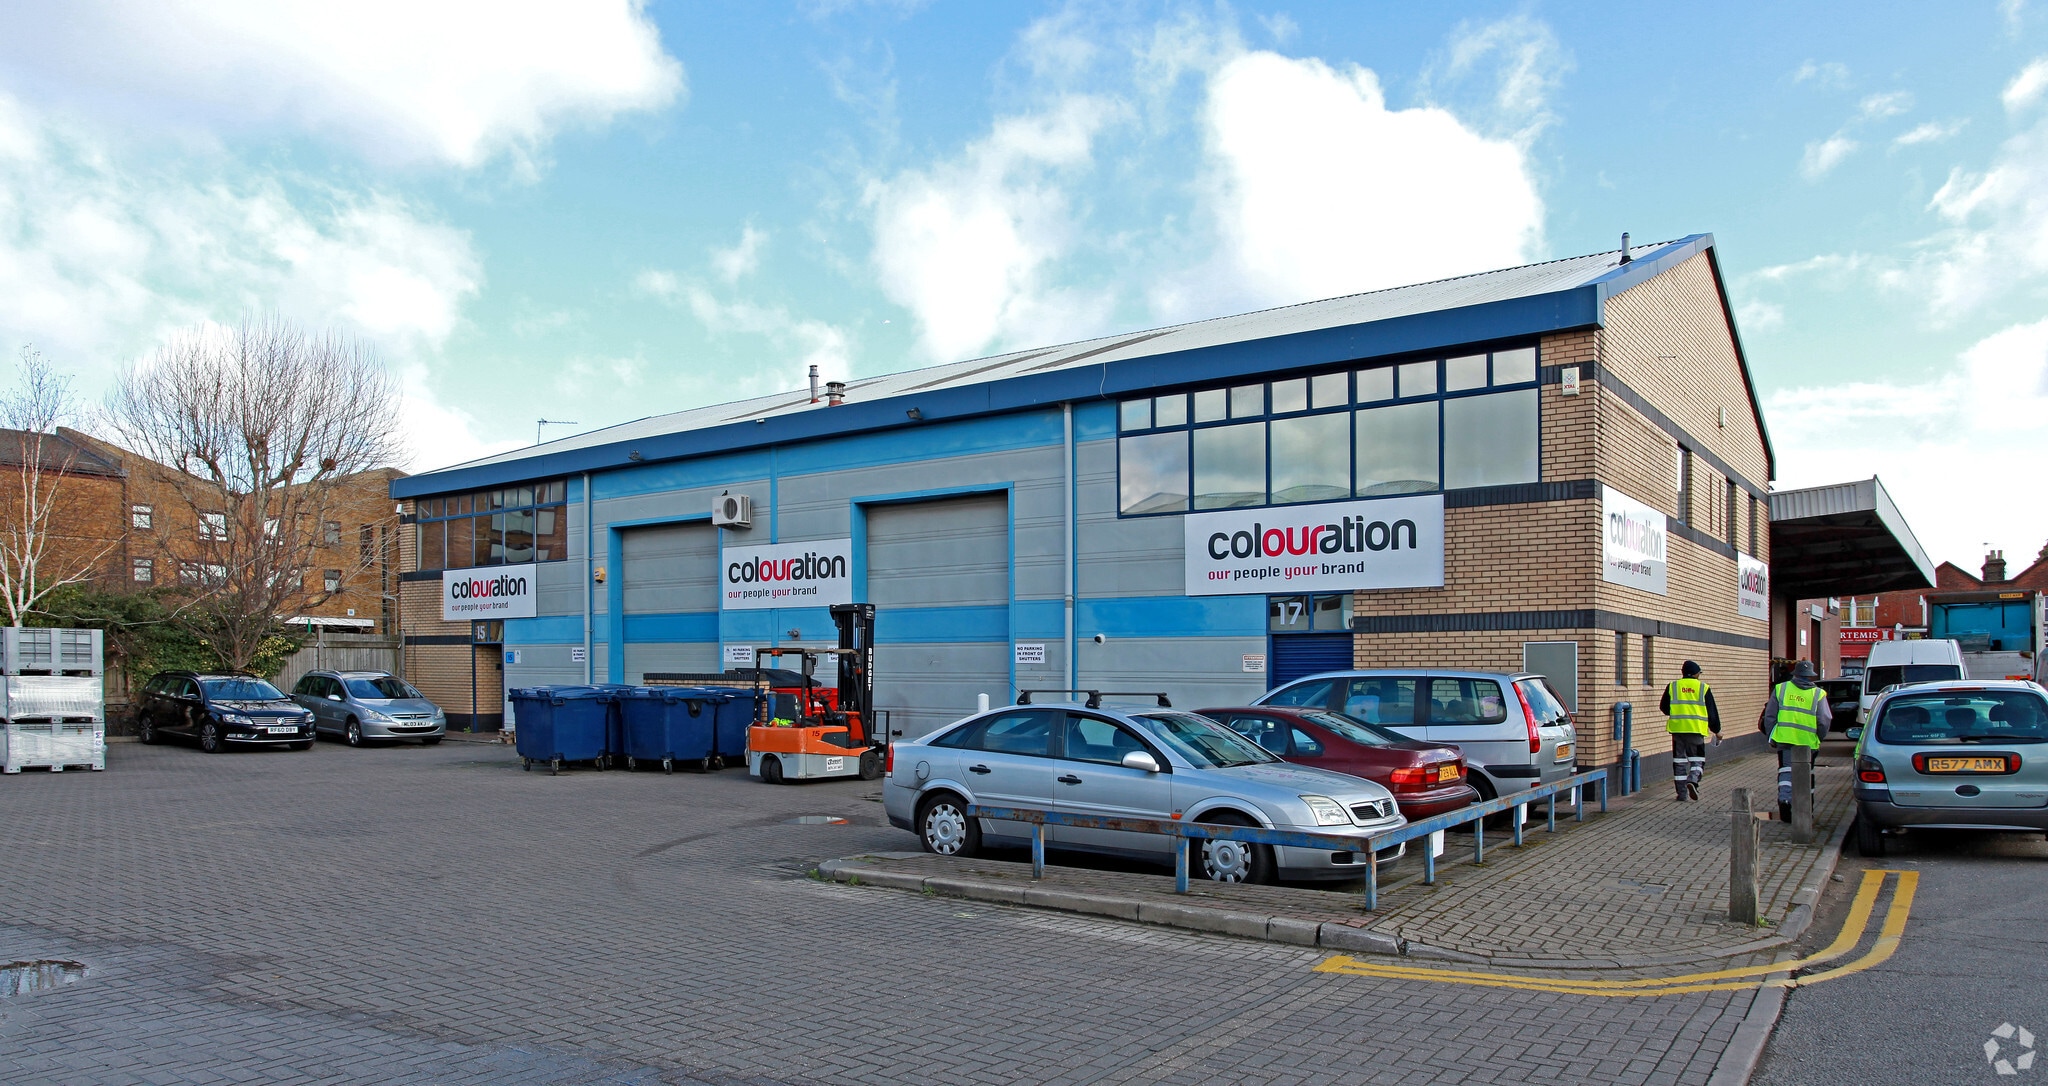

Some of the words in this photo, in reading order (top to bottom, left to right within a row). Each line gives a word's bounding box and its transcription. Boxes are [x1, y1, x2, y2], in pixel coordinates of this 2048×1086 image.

[1208, 515, 1417, 560] colouration
[1610, 510, 1662, 560] colouration
[728, 552, 846, 584] colouration
[1208, 570, 1230, 580] our
[1234, 566, 1280, 581] people
[1284, 565, 1318, 580] your
[1322, 561, 1364, 575] brand
[452, 574, 526, 600] colouration
[728, 590, 742, 598] our
[743, 588, 770, 599] people
[772, 588, 791, 599] your
[792, 586, 817, 596] brand
[461, 602, 478, 612] people
[479, 604, 492, 612] your
[492, 601, 508, 609] brand
[1278, 602, 1302, 625] 17
[477, 626, 486, 640] 15
[1931, 760, 1969, 769] R577
[1974, 760, 2002, 769] AMX
